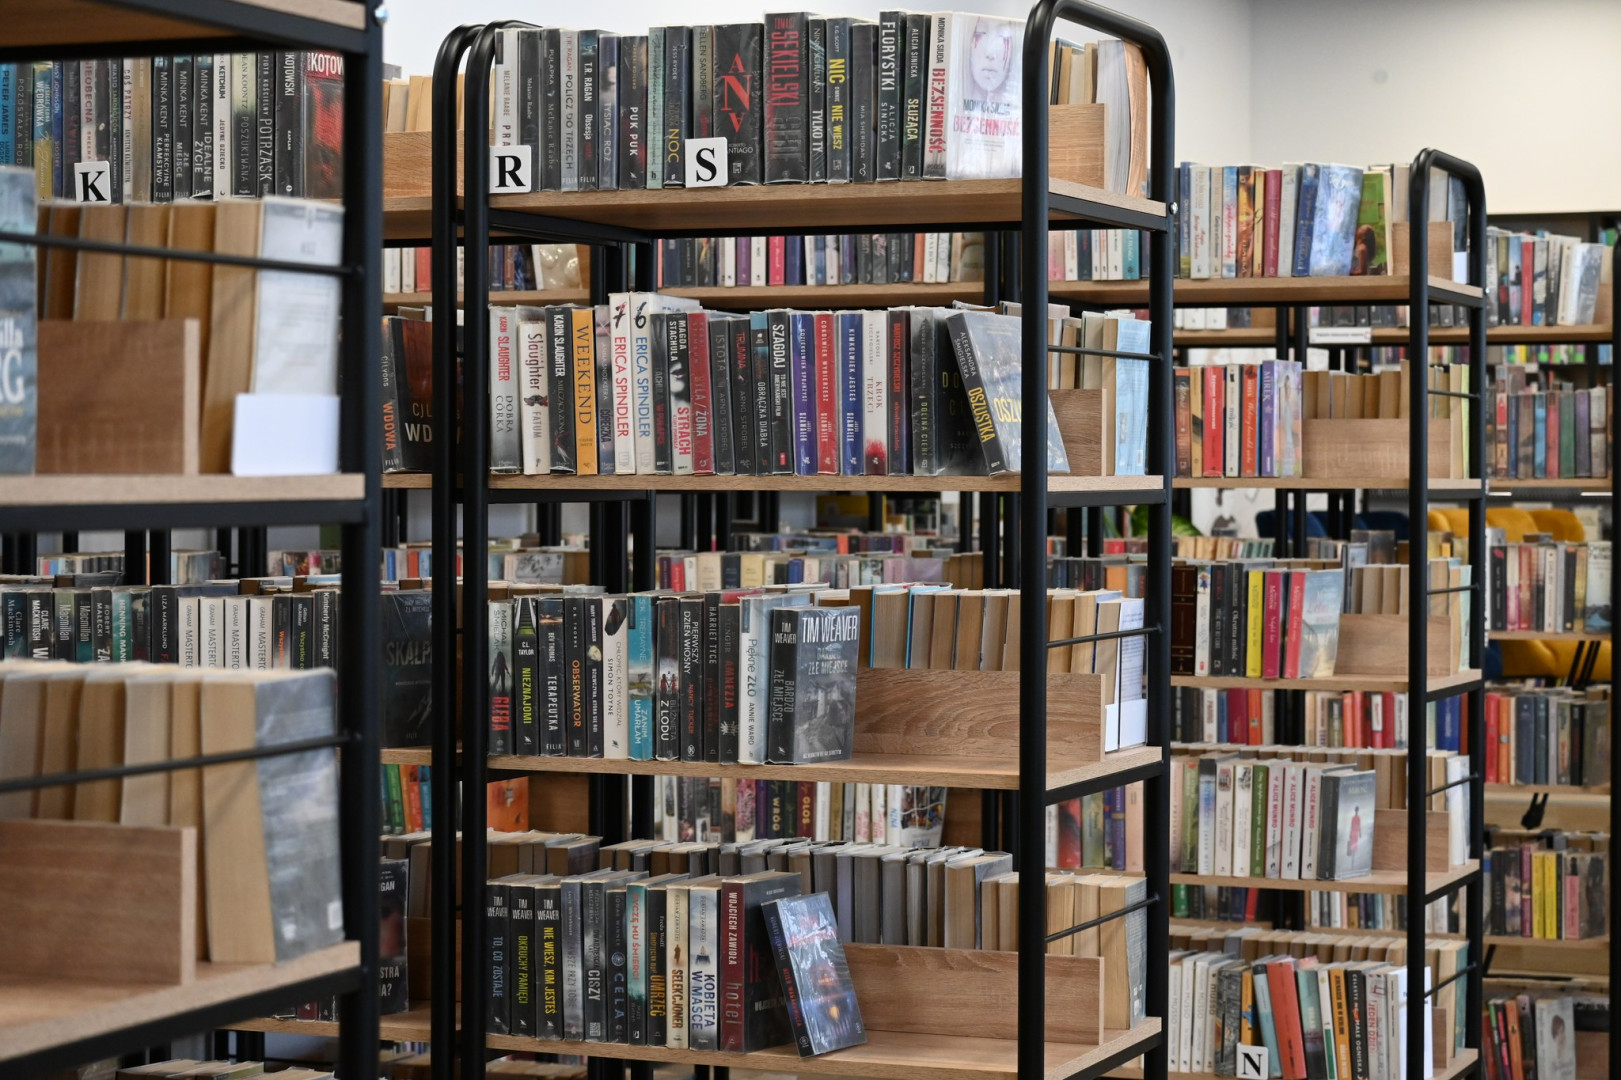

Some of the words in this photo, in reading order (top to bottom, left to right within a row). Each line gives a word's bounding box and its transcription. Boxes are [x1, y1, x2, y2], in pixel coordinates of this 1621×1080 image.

[937, 18, 945, 43] MONIKA
[772, 32, 799, 106] SEKIELSKI
[882, 22, 896, 91] FLORYSTKI
[936, 45, 944, 64] SIUDA
[200, 70, 208, 100] MINKA
[284, 55, 295, 96] KOTOWSKI
[829, 59, 845, 84] NIC
[584, 78, 593, 101] RAGAN
[200, 103, 208, 126] KENT
[566, 113, 573, 128] DO
[584, 114, 593, 140] Obsesja
[630, 107, 638, 128] PUK
[813, 110, 823, 138] TYLKO
[832, 106, 843, 122] NIE
[906, 99, 919, 140] SŁUŻĄCA
[929, 68, 946, 154] BEZSENNOŚĆ
[241, 117, 249, 182] POSZUKIWANA
[260, 119, 272, 181] POTRZASK
[630, 134, 638, 155] PUK
[668, 129, 679, 163] NOC
[813, 141, 823, 153] TY
[833, 126, 843, 150] WIESZ
[195, 141, 204, 173] ŻYCIE
[204, 132, 212, 183] IDEALNE
[497, 155, 525, 188] R
[695, 147, 717, 182] S
[80, 170, 107, 202] K
[554, 315, 564, 335] KARIN
[670, 321, 678, 361] STACHULA
[678, 321, 686, 350] MAGDA
[498, 336, 510, 381] SLAUGHTER
[526, 334, 544, 389] Slaughter
[555, 337, 565, 376] SLAUGHTER
[615, 337, 626, 375] ERICA
[636, 337, 648, 374] ERICA
[716, 335, 726, 372] ISTOTA
[772, 325, 786, 368] SZAGDAJ
[960, 332, 977, 376] ALEKSANDRA
[576, 326, 592, 424] WEEKEND
[616, 378, 629, 437] SPINDLER
[637, 378, 649, 437] SPINDLER
[756, 382, 765, 418] OBRĄCZKA
[875, 381, 883, 408] KROK
[383, 402, 396, 450] WDOWA
[496, 396, 504, 432] CÓRKA
[533, 412, 542, 438] FATUM
[696, 411, 710, 436] ŻONA
[968, 387, 996, 443] OSZUSTKA
[678, 408, 690, 455] STRACH
[32, 600, 41, 640] MACKINTOSH
[41, 610, 49, 630] CLARE
[59, 605, 72, 640] Macmillan
[80, 606, 91, 641] Macmillan
[322, 593, 330, 622] Kimberly
[684, 611, 692, 636] DZIEŃ
[322, 624, 330, 659] McCreight
[775, 633, 797, 644] WEAVER
[802, 617, 820, 643] TIM
[821, 615, 857, 642] WEAVER
[747, 639, 757, 672] Piękne
[725, 660, 734, 708] AMNEZJA
[747, 676, 757, 697] ZŁO
[774, 670, 784, 683] ZŁE
[522, 668, 532, 724] NIEZNAJOMI
[548, 676, 558, 730] TERAPEUTKA
[572, 660, 582, 727] OBSERWATOR
[771, 686, 783, 722] MIEJSCE
[785, 680, 794, 712] BARDZO
[661, 710, 669, 740] LODU
[487, 907, 508, 917] WEAVER
[494, 896, 503, 906] TIM
[512, 909, 533, 920] WEAVER
[518, 899, 527, 908] TIM
[537, 910, 559, 920] WEAVER
[544, 899, 553, 909] TIM
[728, 892, 737, 930] WOJCIECH
[544, 927, 554, 939] NIE
[728, 932, 737, 965] ZAWIOŁA
[493, 951, 503, 960] CO
[518, 936, 529, 970] OKRUCHY
[493, 966, 503, 997] ZOSTAJE
[516, 973, 528, 1004] PAMIĘCI
[545, 970, 555, 984] KIM
[589, 970, 600, 1001] CISZY
[692, 971, 702, 982] W
[545, 987, 557, 1014] JESTEŚ
[614, 973, 624, 1018] CELA
[671, 970, 683, 1028] SELEKCJONER
[692, 986, 702, 1030] MASCE
[704, 974, 715, 1027] KOBIETA
[725, 982, 742, 1024] hotel
[1241, 1052, 1262, 1076] N
